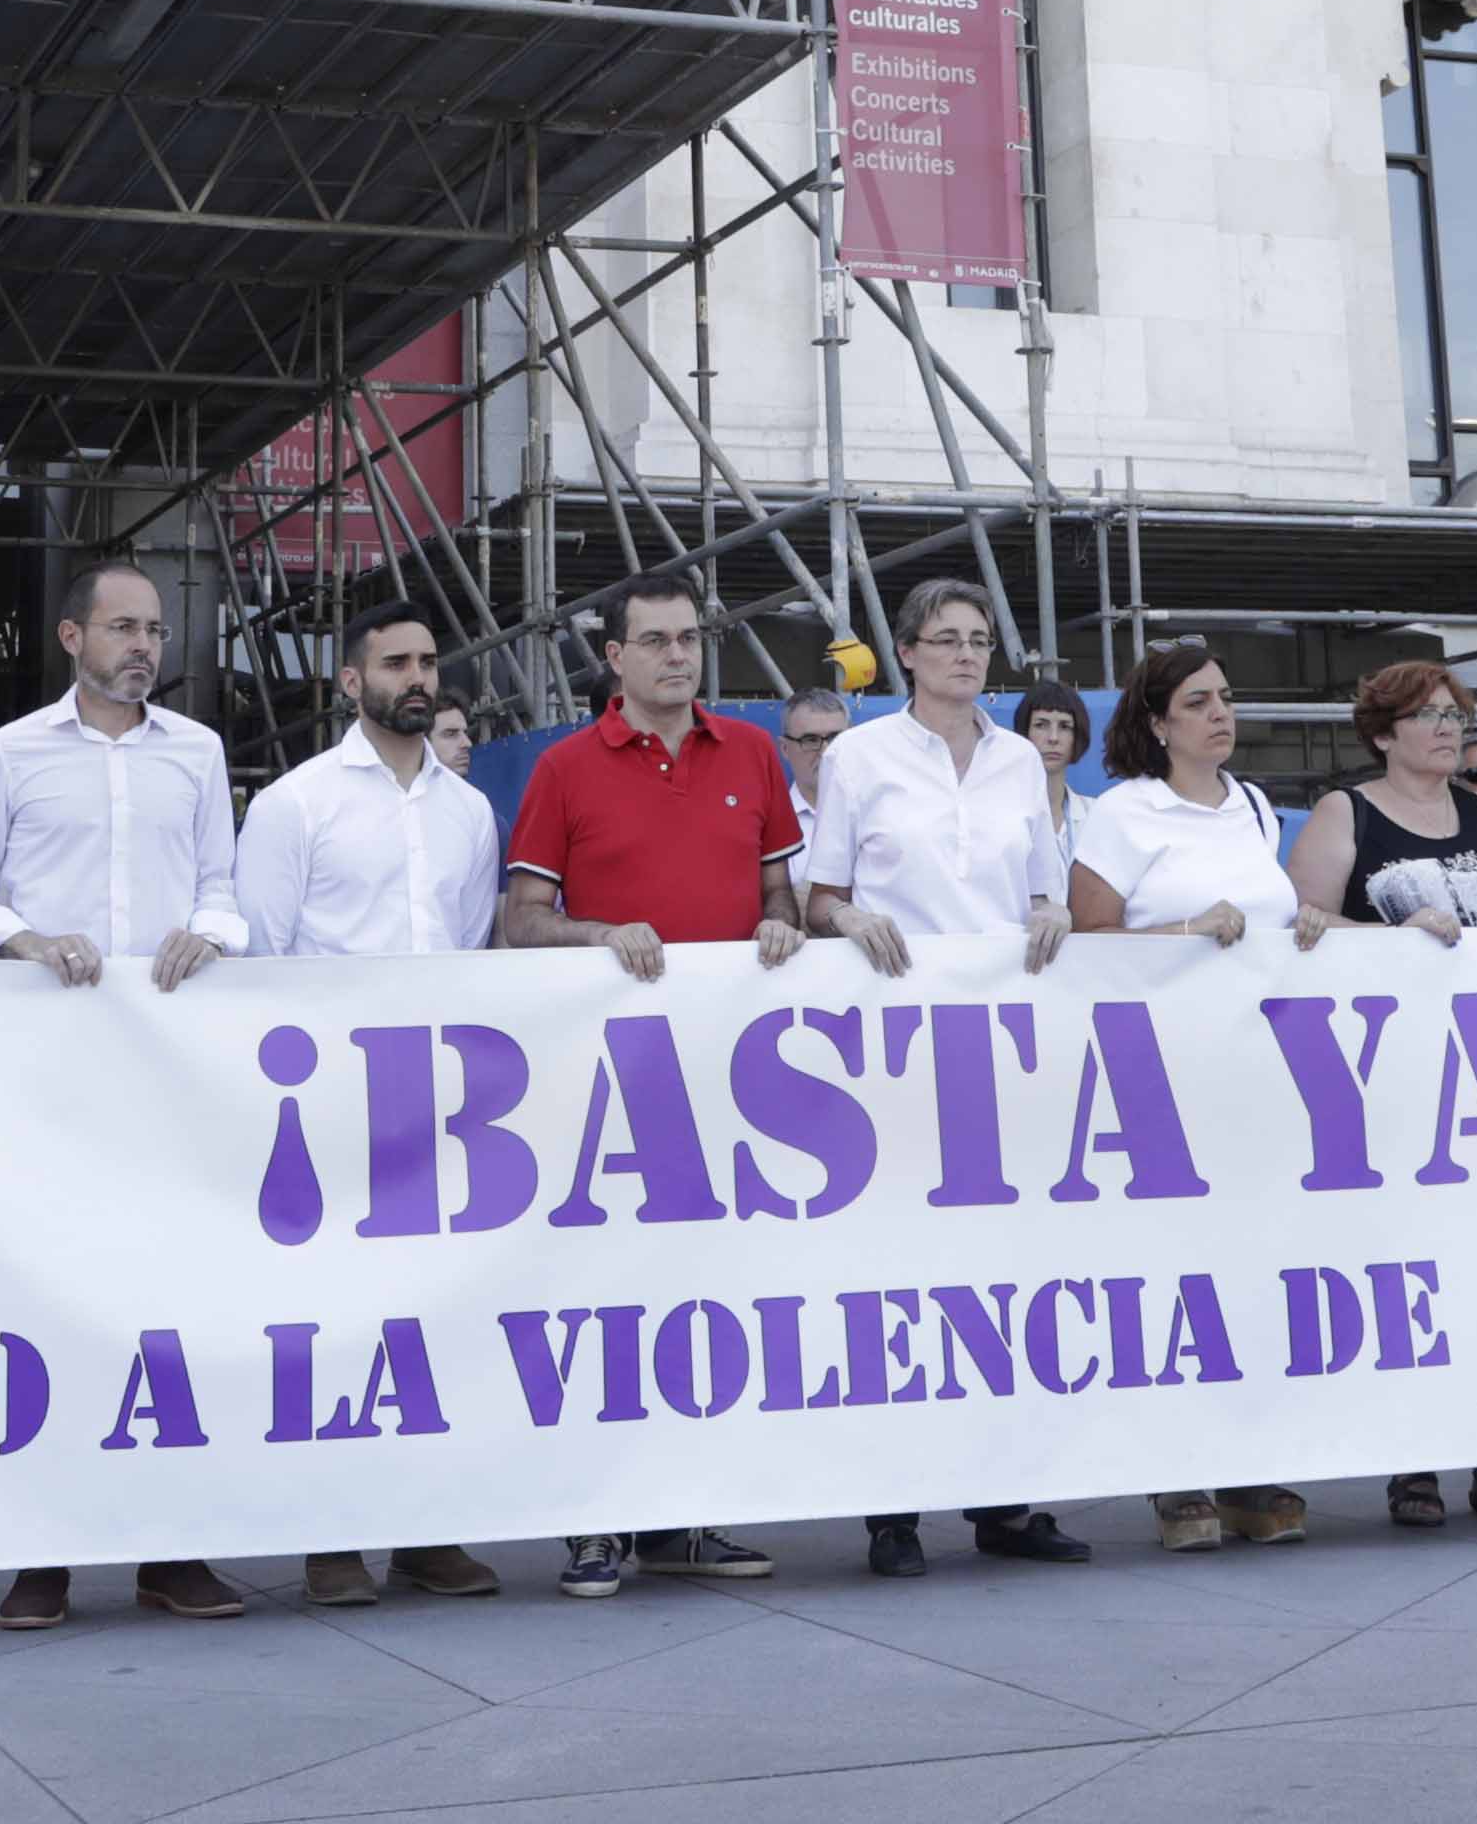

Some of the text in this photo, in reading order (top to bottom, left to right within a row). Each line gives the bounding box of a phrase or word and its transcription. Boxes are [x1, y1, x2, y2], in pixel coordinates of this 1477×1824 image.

[849, 6, 961, 35] culturales
[851, 52, 976, 85] Exhibitions
[851, 86, 950, 114] Concerts
[852, 119, 942, 146] Cultural
[852, 150, 956, 176] activities
[257, 999, 1211, 1247] ¡BASTA
[100, 1328, 209, 1450] A
[263, 1317, 450, 1444] LA
[497, 1272, 1244, 1428] VIOLENCIA
[1284, 1259, 1452, 1376] DE
